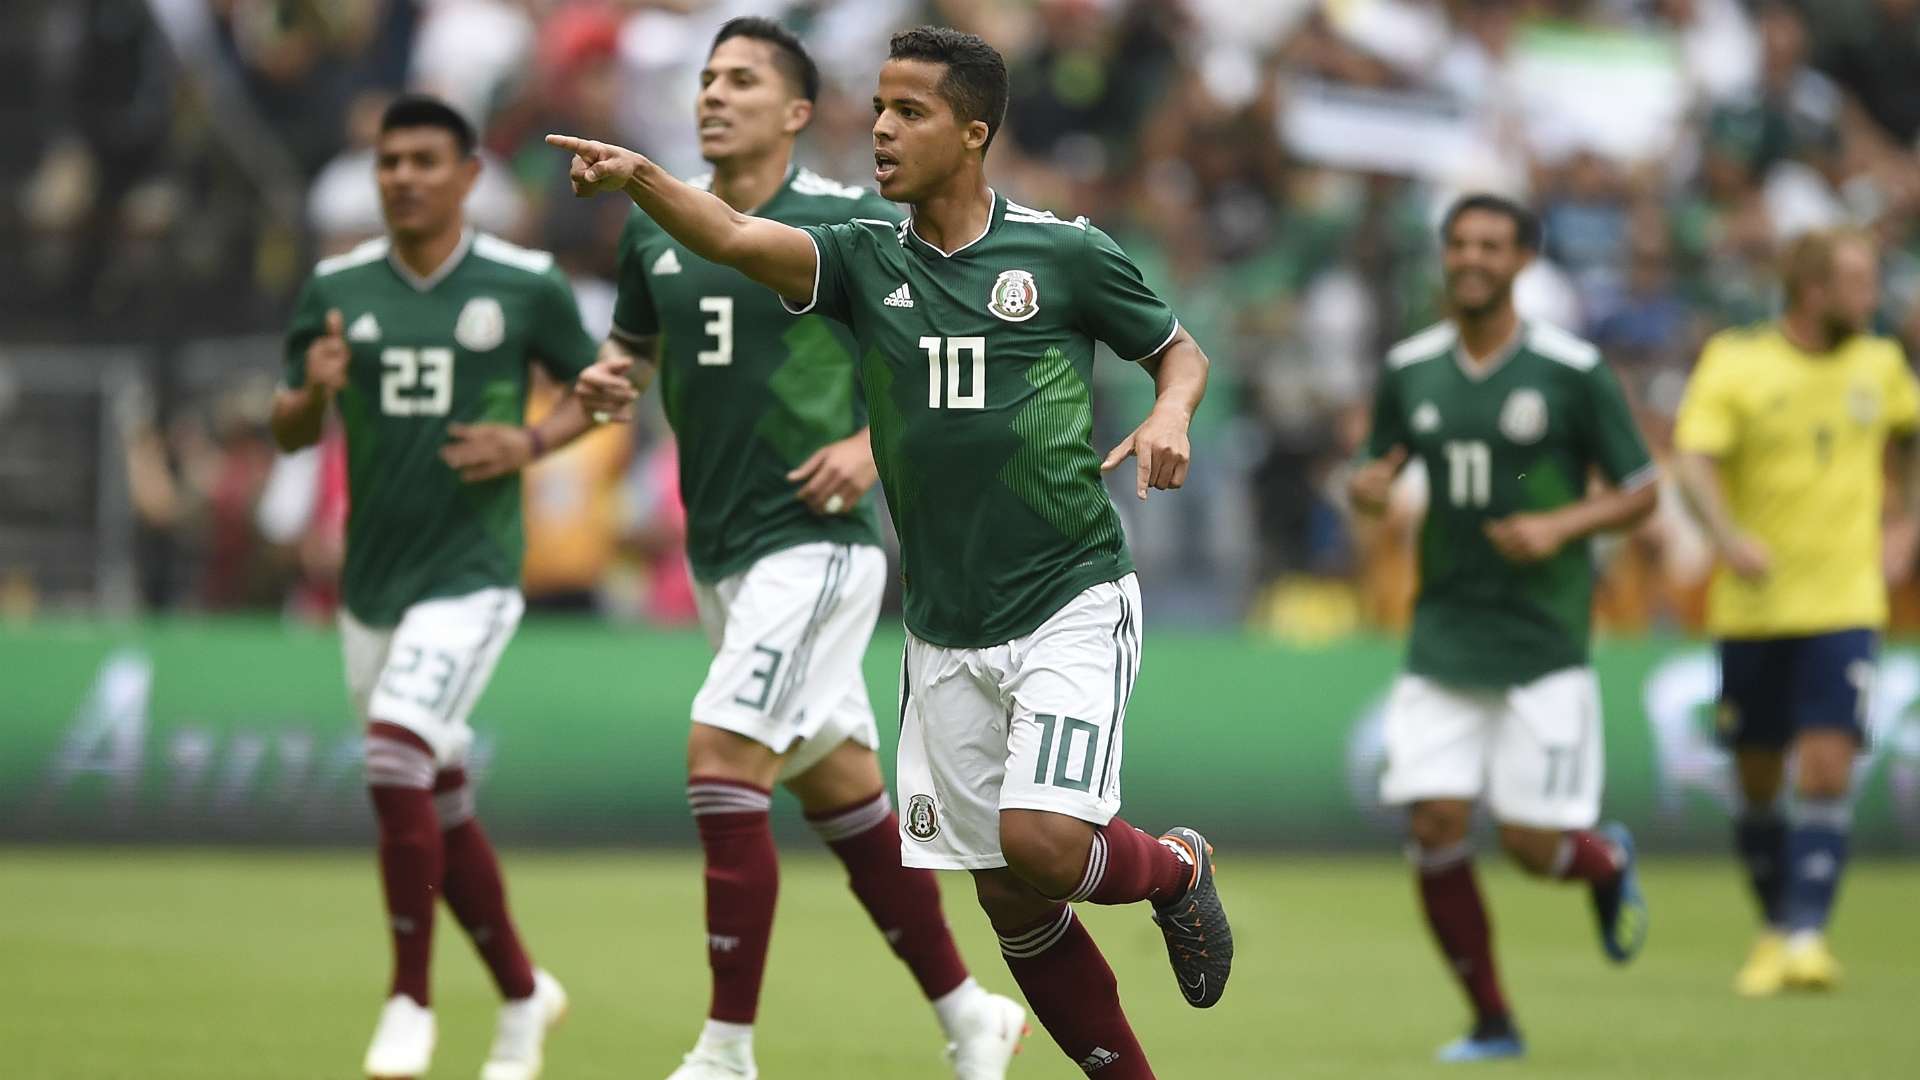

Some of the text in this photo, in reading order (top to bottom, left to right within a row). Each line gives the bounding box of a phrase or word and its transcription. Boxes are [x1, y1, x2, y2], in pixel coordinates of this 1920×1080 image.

[698, 297, 733, 365] 3
[883, 297, 914, 308] adidas
[380, 347, 454, 416] 23
[919, 336, 986, 409] 10
[1444, 439, 1492, 508] 11
[383, 645, 456, 710] 23
[734, 643, 784, 710] 3
[1033, 713, 1100, 793] 10
